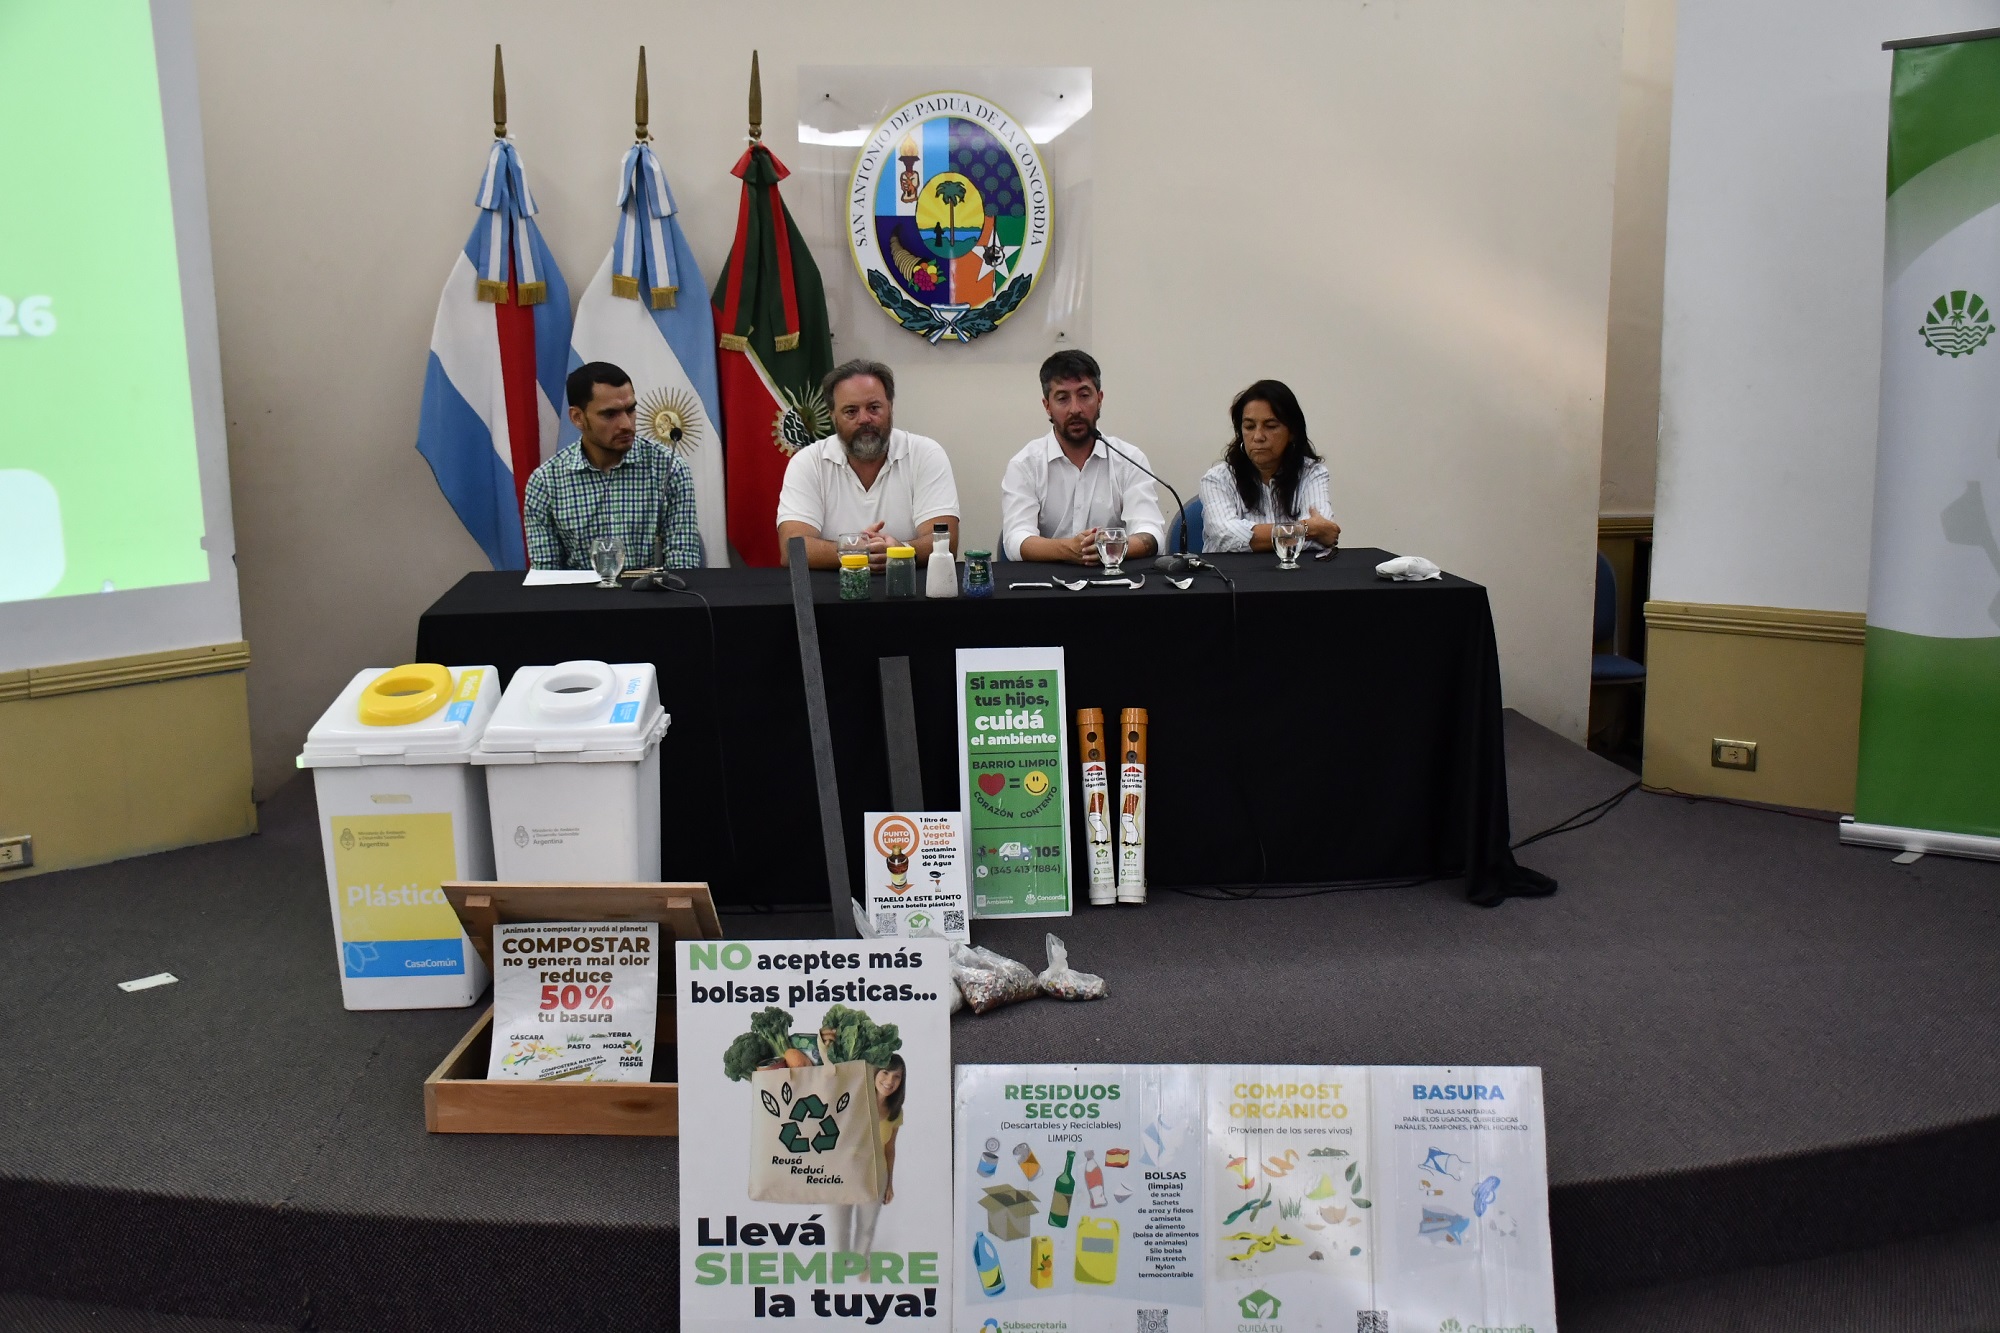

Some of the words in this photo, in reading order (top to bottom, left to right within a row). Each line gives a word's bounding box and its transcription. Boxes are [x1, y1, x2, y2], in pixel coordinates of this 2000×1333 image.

[915, 98, 971, 116] PADUA
[890, 109, 914, 131] DE
[975, 104, 999, 126] DE
[998, 120, 1016, 143] LA
[854, 129, 891, 208] ANTONIO
[1015, 142, 1045, 246] CONCORDIA
[853, 214, 867, 247] SAN
[970, 676, 985, 690] Si
[989, 676, 1034, 689] amás
[1038, 678, 1048, 689] a
[974, 695, 1002, 706] tus
[1005, 691, 1050, 708] hijos,
[974, 708, 1044, 731] cuidá
[970, 734, 985, 746] el
[987, 731, 1057, 745] ambiente
[972, 760, 1016, 769] BARRIO
[1018, 758, 1058, 768] LIMPIO
[973, 791, 1014, 818] CORAZÓN
[1020, 786, 1058, 819] CONTENTO
[923, 831, 955, 839] Vegetal
[1035, 846, 1060, 857] 105
[990, 866, 1011, 875] (345
[347, 883, 447, 907] Plástico
[502, 937, 650, 954] COMPOSTAR
[404, 957, 457, 968] CasaComún
[503, 957, 523, 967] no
[528, 956, 582, 969] genera
[586, 955, 614, 966] mal
[619, 955, 650, 966] olor
[689, 943, 752, 971] NO
[757, 950, 860, 975] aceptes
[868, 947, 923, 969] más
[540, 968, 613, 983] reduce
[539, 984, 614, 1010] 50%
[691, 980, 780, 1003] bolsas
[788, 977, 937, 1008] plásticas...
[538, 1013, 554, 1023] tu
[560, 1011, 613, 1023] basura
[541, 1061, 577, 1073] COMPOSTERA
[578, 1055, 604, 1064] NATURAL
[1004, 1084, 1121, 1100] RESIDUOS
[1233, 1083, 1343, 1099] COMPOST
[1412, 1084, 1505, 1100] BASURA
[1025, 1102, 1101, 1119] SECOS
[1000, 1121, 1060, 1130] (Descartables
[1062, 1123, 1068, 1131] y
[1070, 1121, 1121, 1130] Reciclables)
[1402, 1115, 1440, 1123] PAÑUELOS
[1440, 1116, 1471, 1124] USADOS,
[1047, 1134, 1083, 1142] LIMPIOS
[1227, 1126, 1274, 1135] (Provienen
[1276, 1126, 1288, 1134] de
[1289, 1126, 1302, 1134] los
[1327, 1126, 1353, 1136] vivos)
[771, 1155, 803, 1165] Reusá
[790, 1165, 824, 1174] Reducí
[1144, 1171, 1187, 1180] BOLSAS
[806, 1175, 844, 1184] Reciclá.
[1147, 1182, 1183, 1191] (limpias)
[697, 1213, 826, 1247] Llevá
[1132, 1231, 1153, 1239] (bolsa
[1154, 1239, 1188, 1247] animales)
[694, 1251, 939, 1286] SIEMPRE
[754, 1286, 796, 1318] la
[810, 1287, 937, 1326] tuya!
[1002, 1320, 1067, 1329] Subsecretaria
[1270, 1325, 1282, 1333] TU
[1467, 1324, 1535, 1333] Concordia
